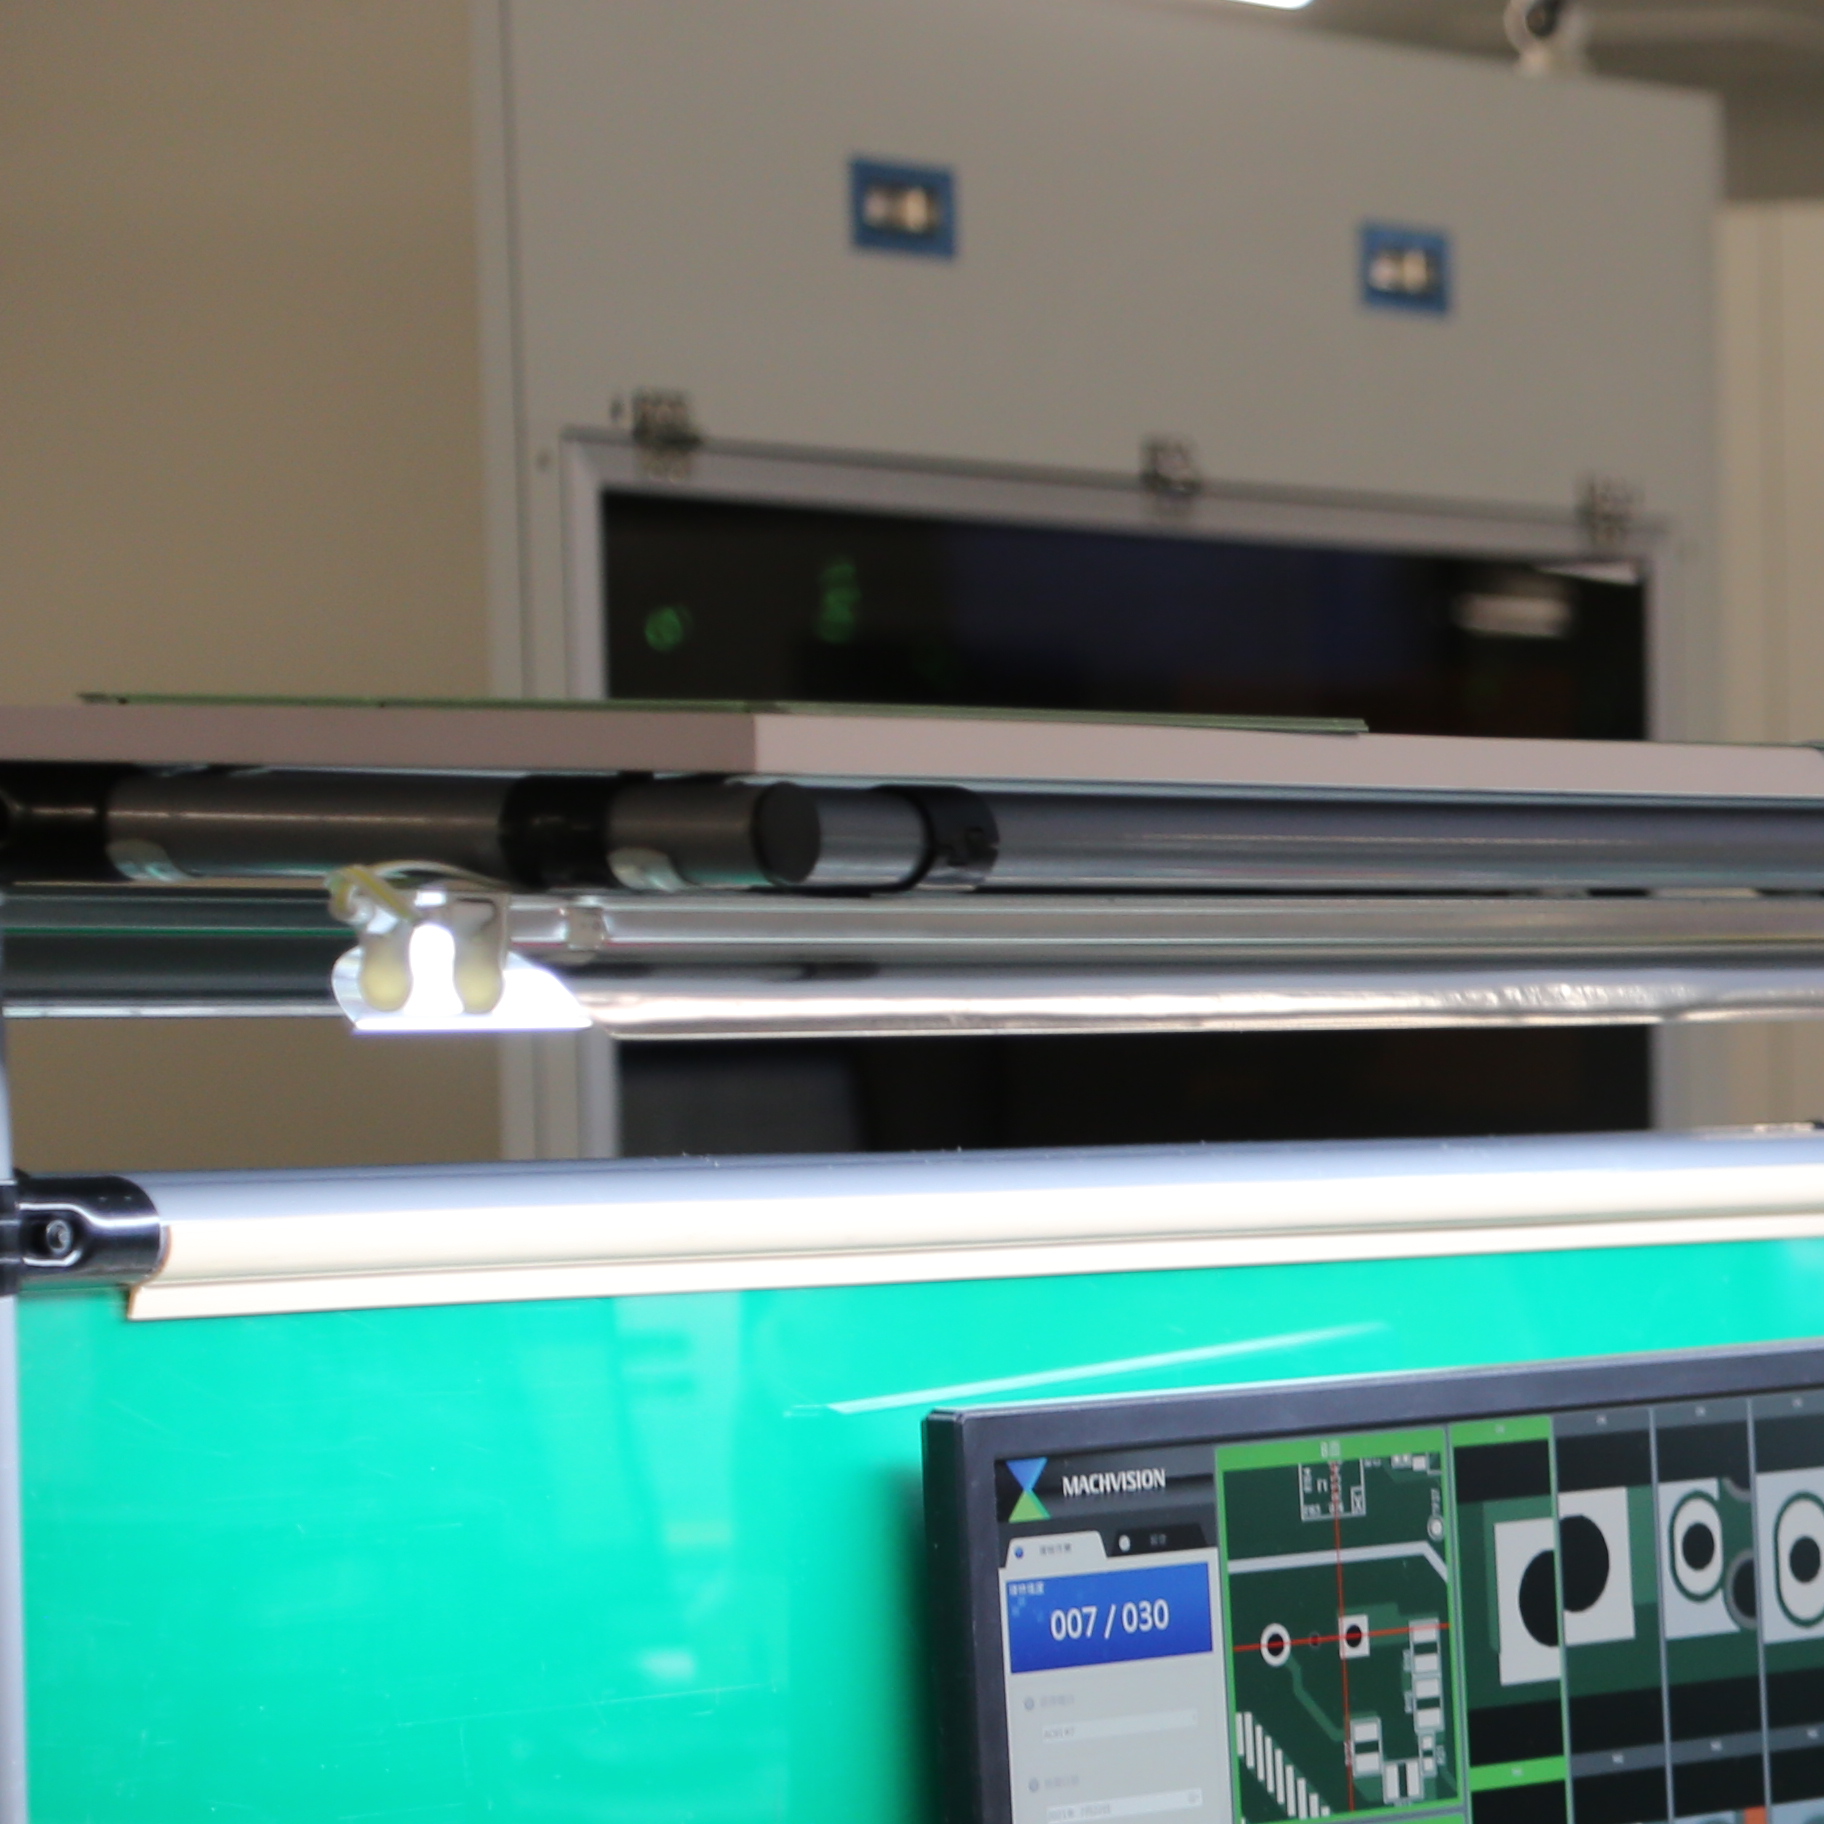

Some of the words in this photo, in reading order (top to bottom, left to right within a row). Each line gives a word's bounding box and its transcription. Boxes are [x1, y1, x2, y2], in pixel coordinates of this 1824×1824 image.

[1062, 1468, 1166, 1497] MACHVISION
[1051, 1605, 1098, 1641] 007
[1104, 1603, 1117, 1640] /
[1122, 1598, 1169, 1634] 030
